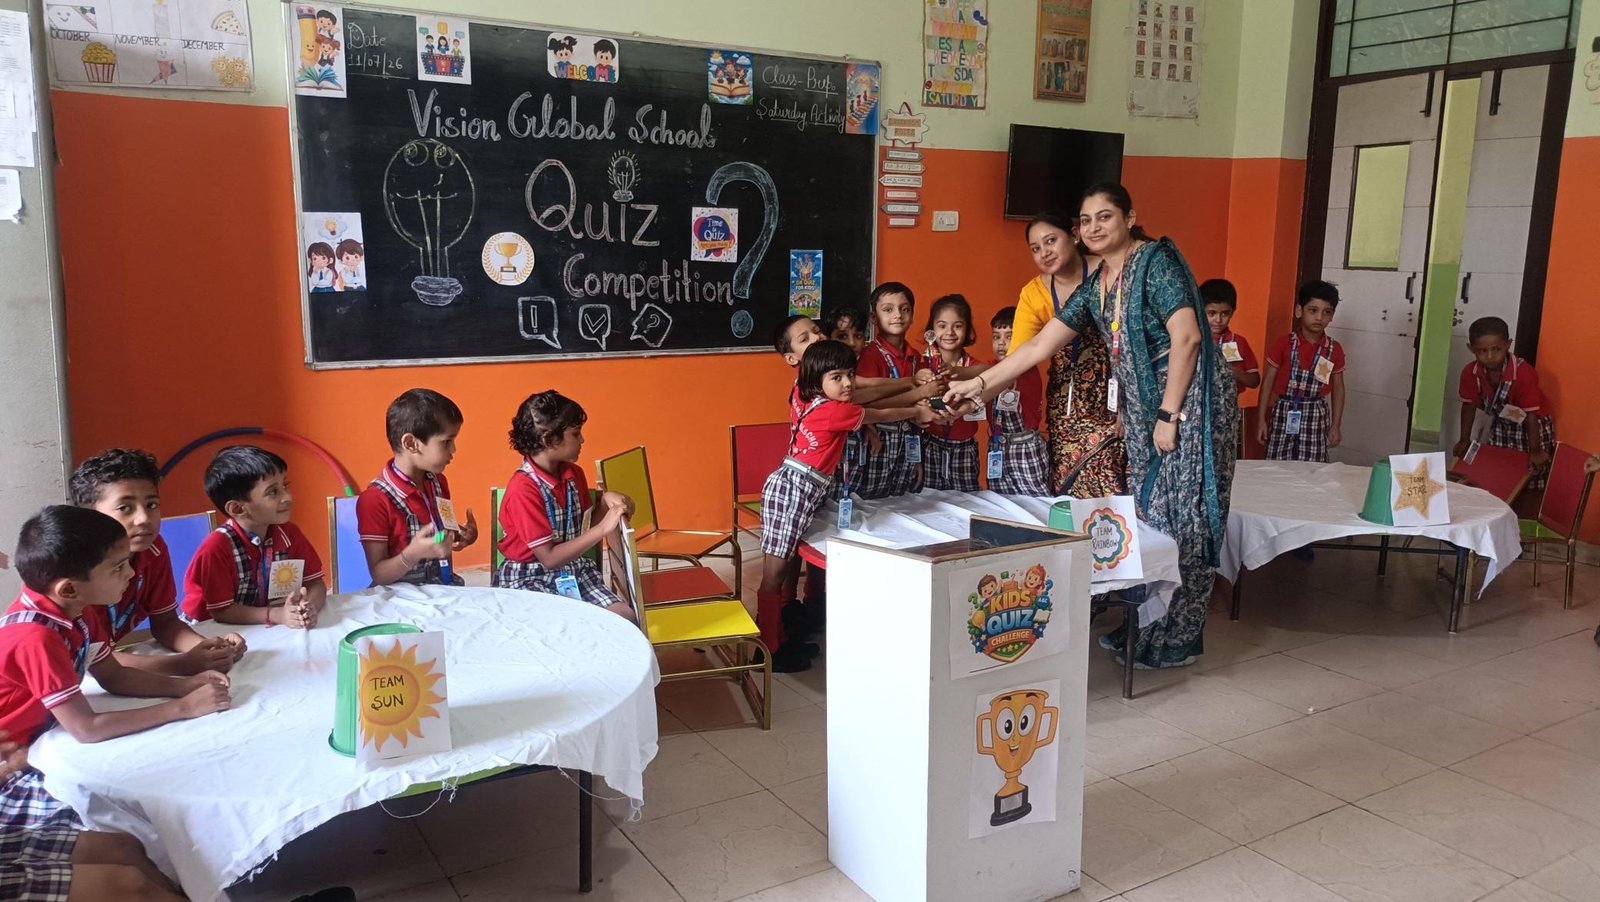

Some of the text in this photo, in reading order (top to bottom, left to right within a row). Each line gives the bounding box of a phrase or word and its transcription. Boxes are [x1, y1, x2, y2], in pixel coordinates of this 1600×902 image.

[50, 29, 226, 51] OCTOBER NOVEMBER DECEMBER
[346, 22, 386, 49] Date
[554, 64, 617, 84] WELCOME
[408, 88, 502, 141] Vision
[506, 90, 617, 141] Global
[755, 96, 846, 134] Saturday Activity
[706, 218, 724, 228] Time
[703, 230, 725, 242] Quiz
[563, 252, 735, 311] Competition
[1410, 476, 1425, 484] TEAM
[1407, 485, 1427, 497] STAR
[1095, 527, 1112, 536] TEAM
[1091, 539, 1120, 551] RAINBOW
[990, 590, 1032, 613] KIDS
[986, 609, 1034, 635] QUIZ
[991, 631, 1030, 646] CHALLENGE
[369, 674, 405, 690] TEAM
[370, 694, 404, 711] SUN
